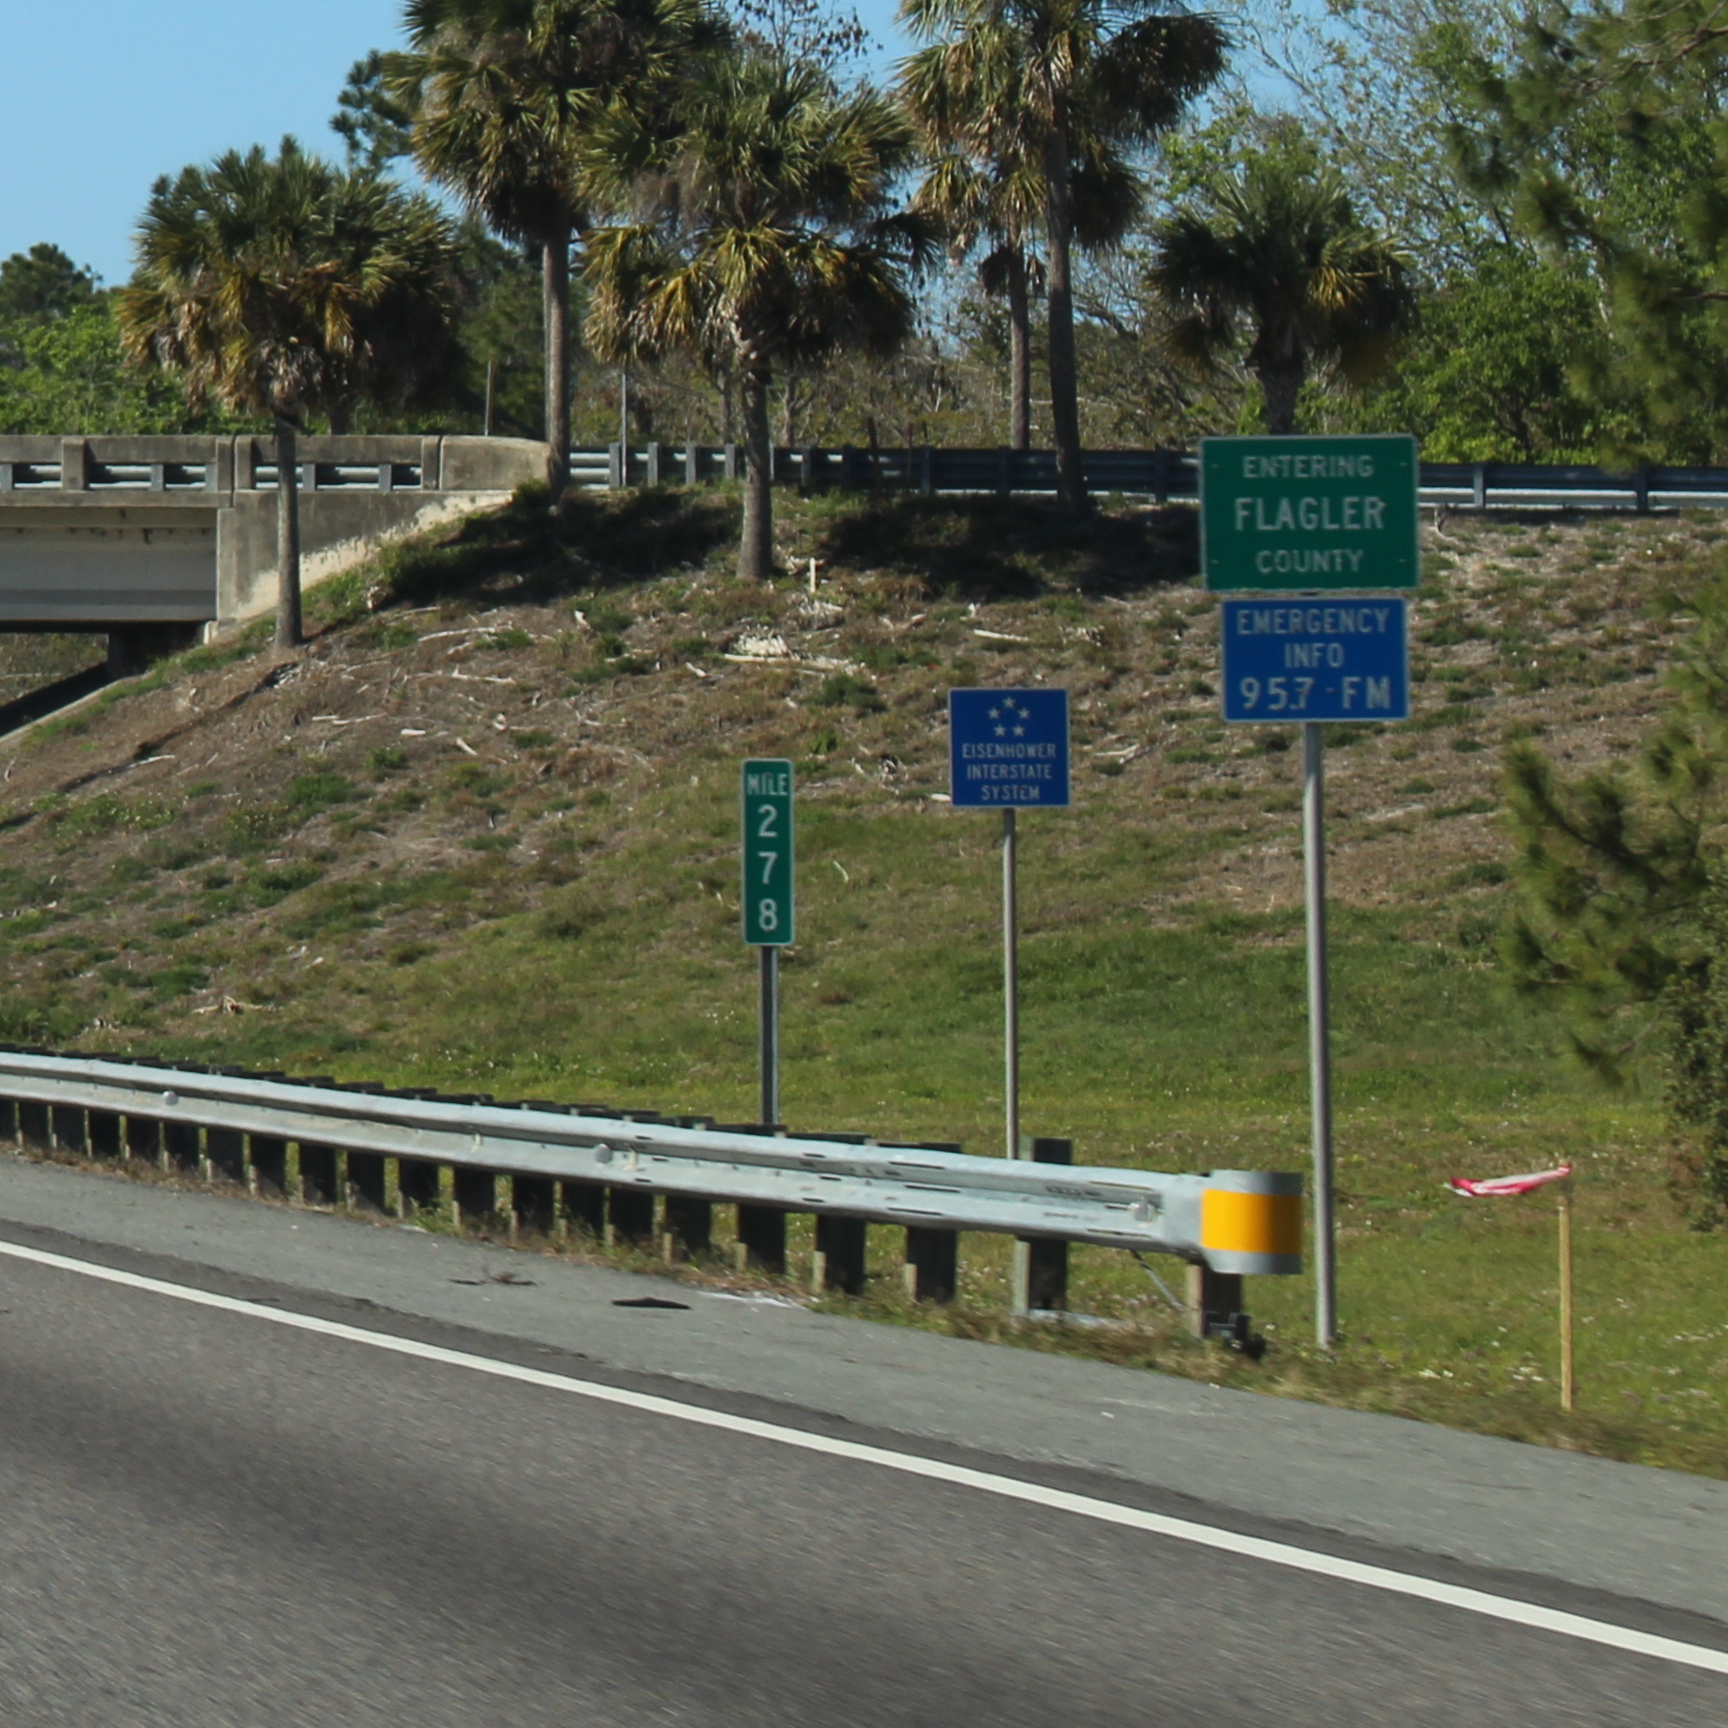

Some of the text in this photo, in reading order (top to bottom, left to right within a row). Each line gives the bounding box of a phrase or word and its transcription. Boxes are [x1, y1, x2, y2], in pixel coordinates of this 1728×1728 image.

[1243, 455, 1375, 479] ENTERING
[1233, 497, 1386, 531] FLAGLER
[1256, 549, 1364, 573] COUNTY
[1236, 608, 1389, 635] EMERGENCY
[1284, 643, 1344, 668] INFO
[1341, 677, 1392, 709] FM
[961, 742, 1057, 759] EISENHOWER
[966, 764, 1053, 780] INTERSTATE
[747, 773, 788, 796] MILE
[981, 784, 1040, 801] SYSTEM
